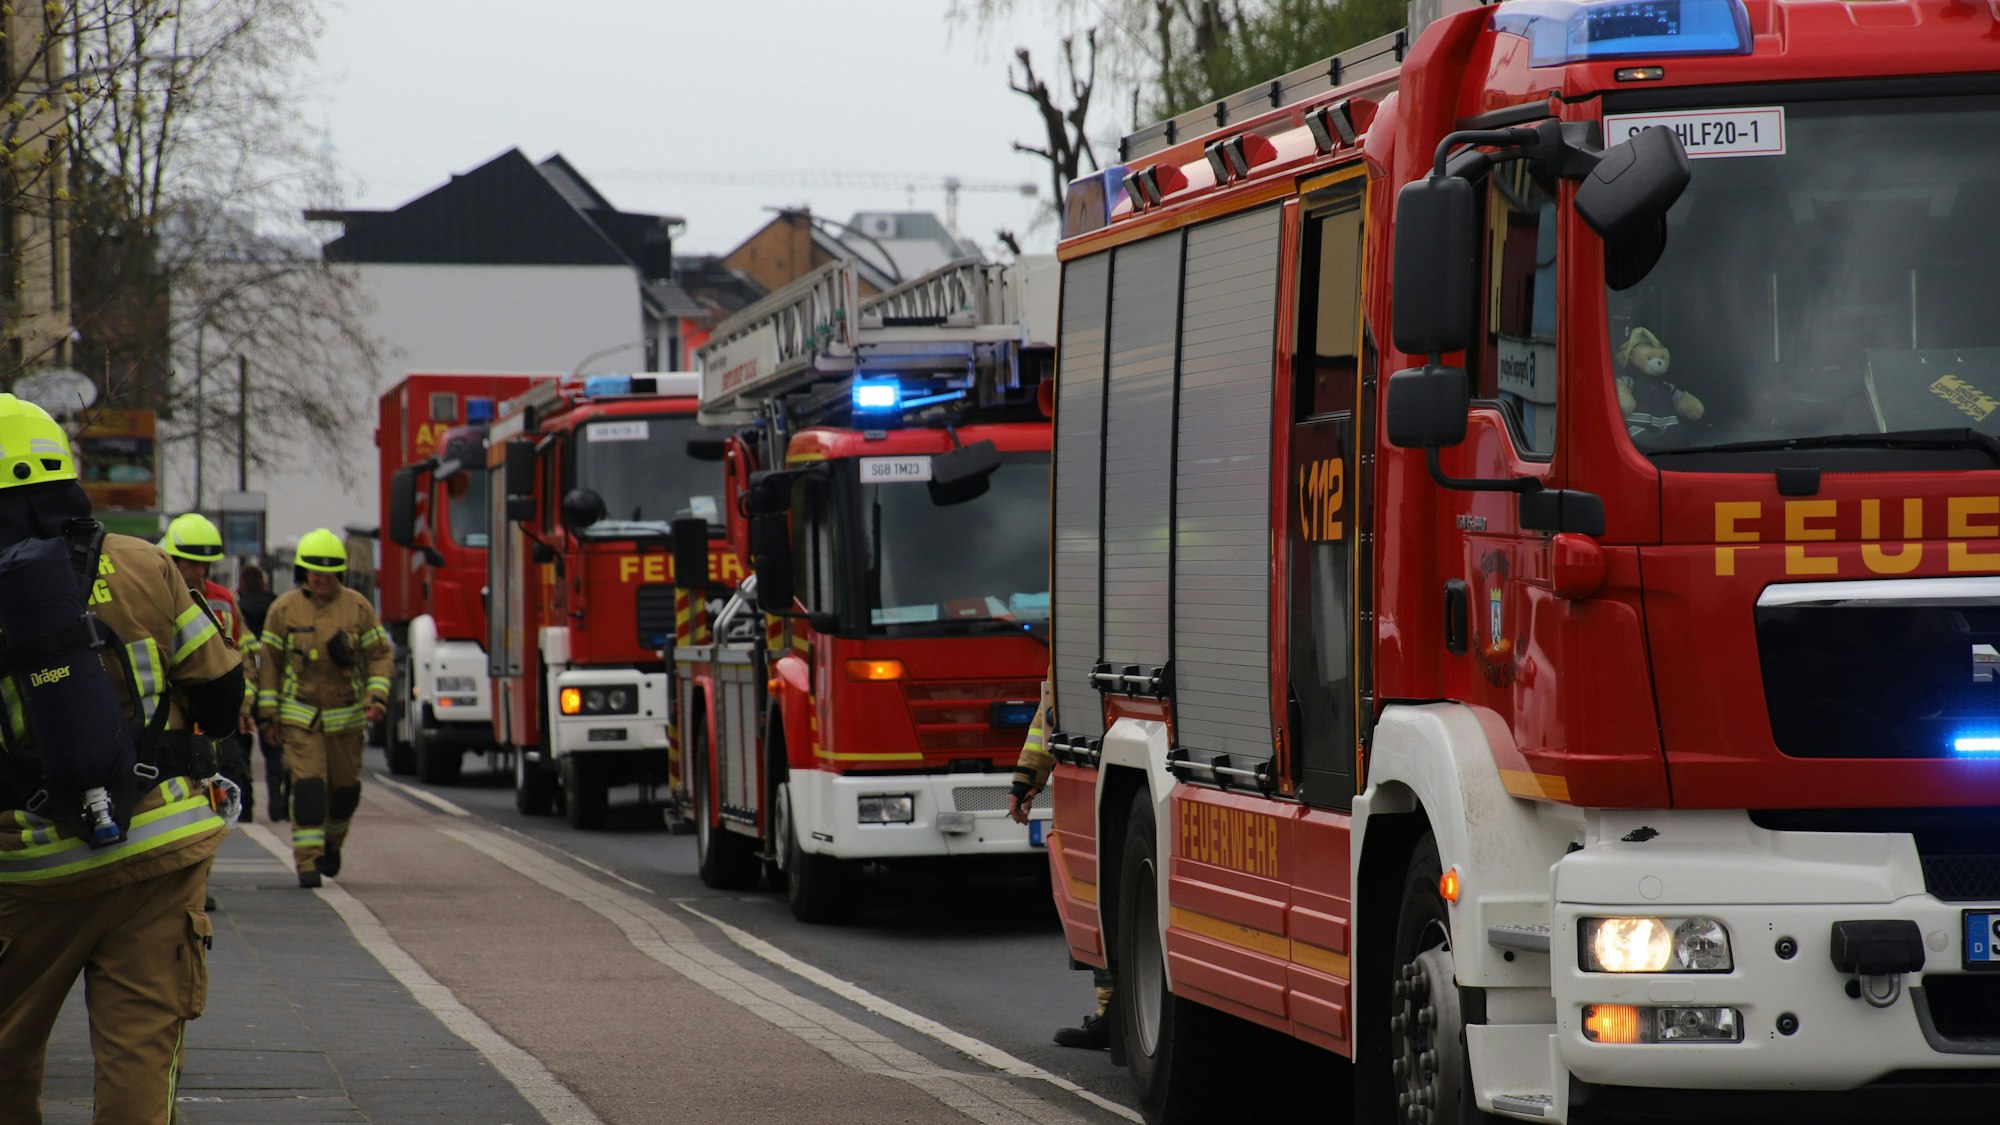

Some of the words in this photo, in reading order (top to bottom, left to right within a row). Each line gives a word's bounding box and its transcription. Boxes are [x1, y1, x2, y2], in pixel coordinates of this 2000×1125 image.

[1676, 120, 1759, 146] HLF20-1
[871, 464, 891, 476] SGB
[894, 463, 919, 475] TM23
[1308, 458, 1343, 541] 112
[1714, 496, 2000, 576] FEUE
[30, 665, 70, 687] Dräger
[1182, 801, 1277, 878] FEUERWEHR
[1974, 942, 1983, 953] D
